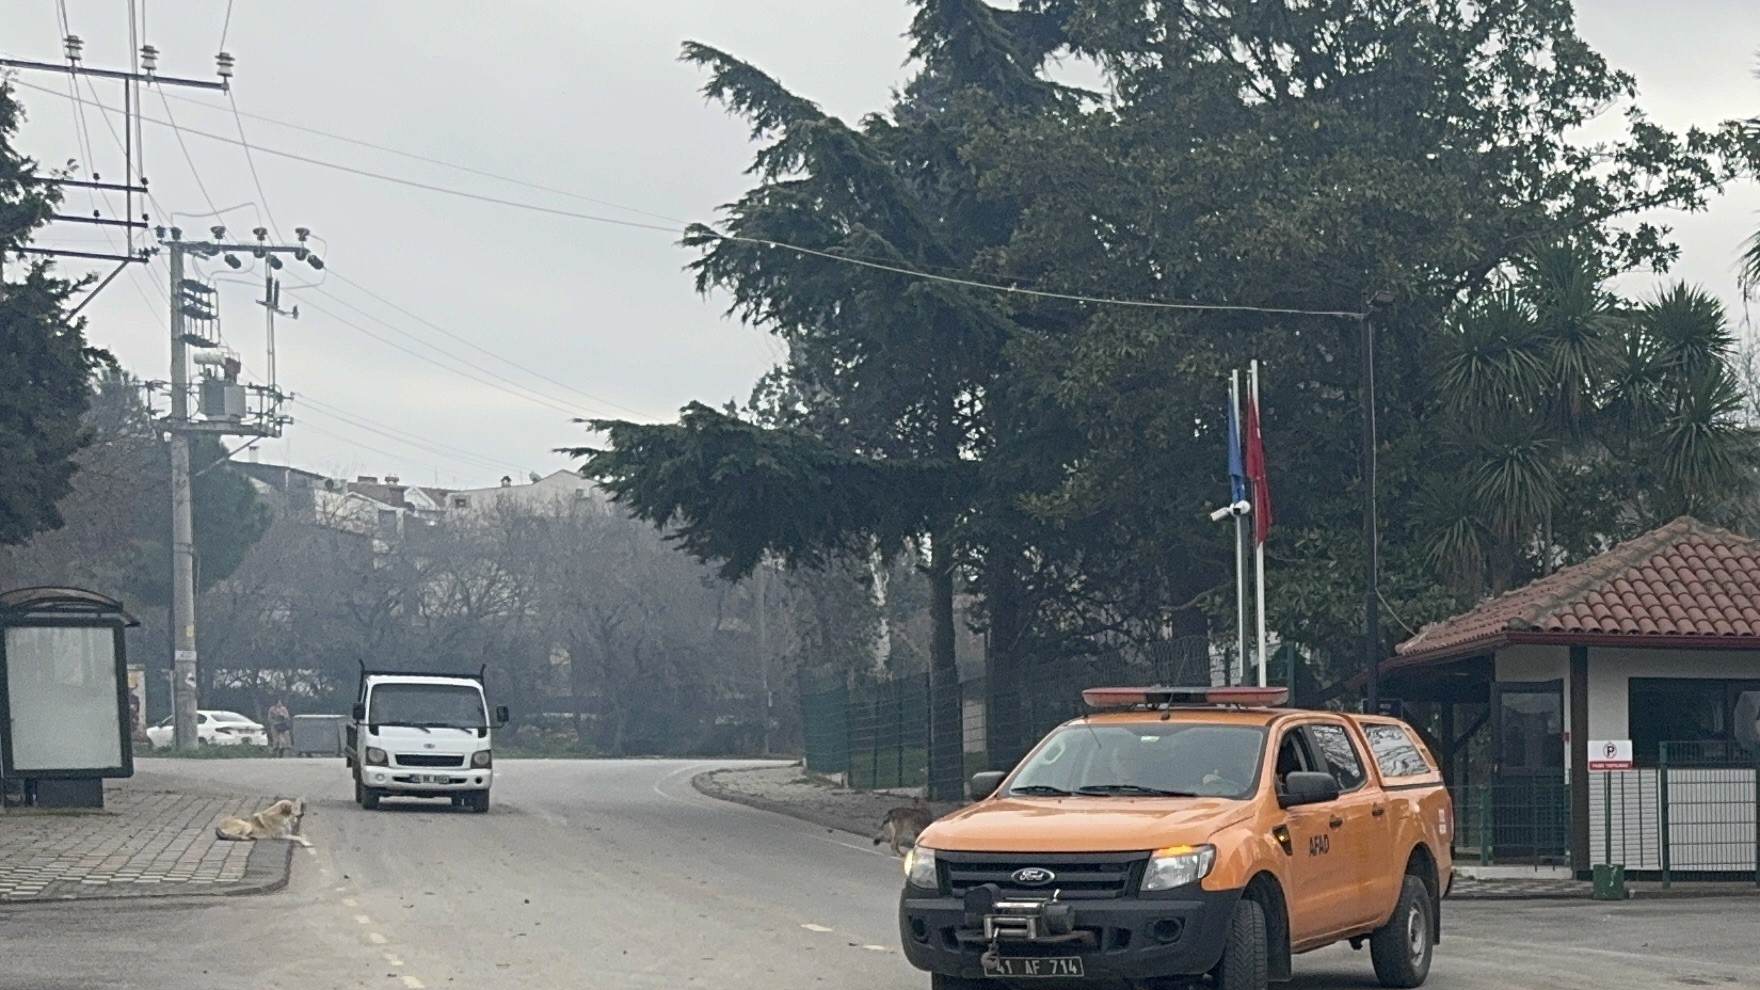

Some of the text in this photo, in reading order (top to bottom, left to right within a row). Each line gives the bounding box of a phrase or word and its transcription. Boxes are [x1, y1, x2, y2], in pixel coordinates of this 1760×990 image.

[1606, 745, 1615, 757] P
[1309, 834, 1330, 857] AFAD
[996, 959, 1078, 975] 41 AF 714
